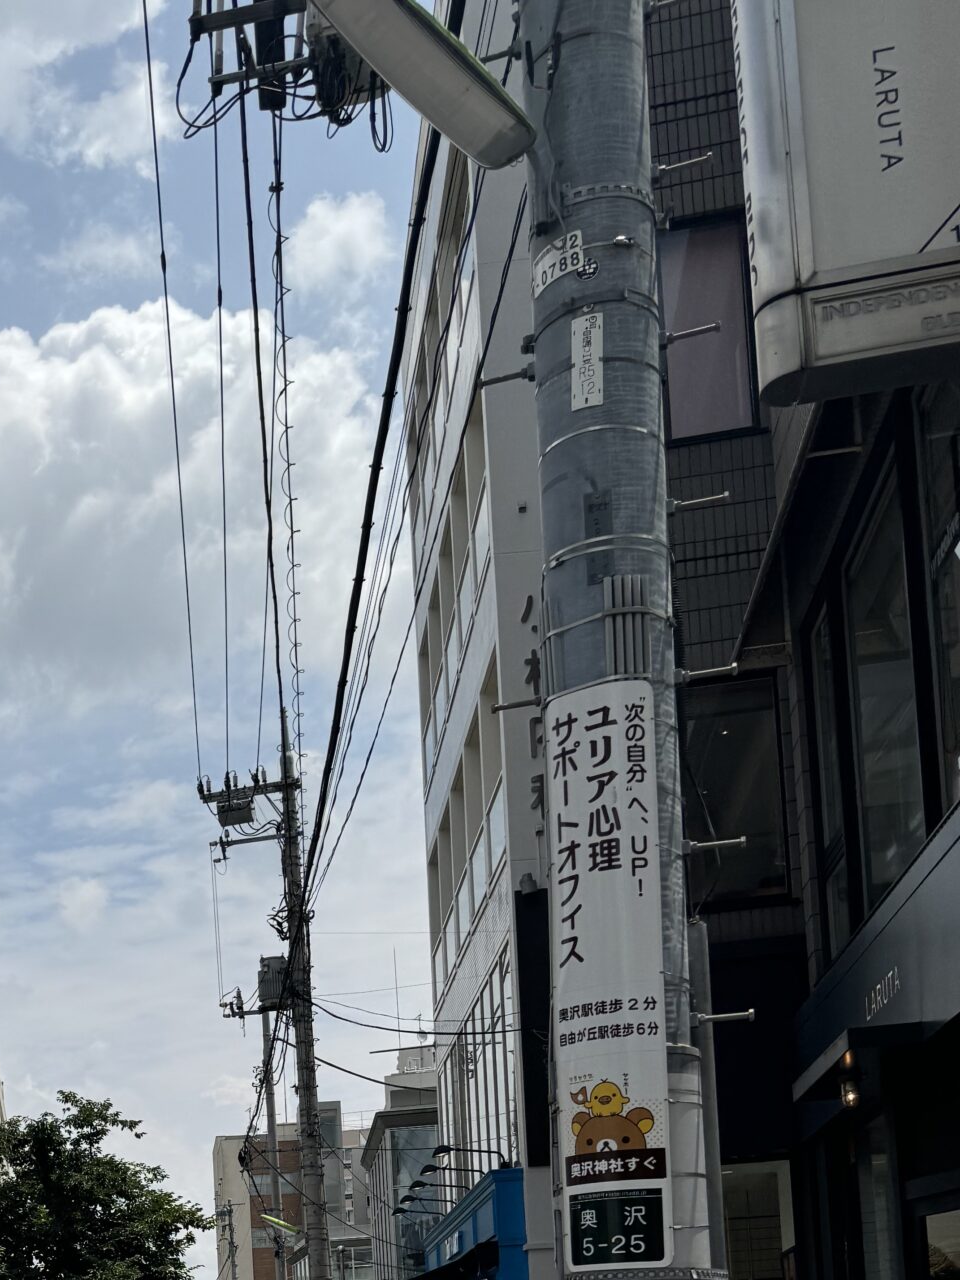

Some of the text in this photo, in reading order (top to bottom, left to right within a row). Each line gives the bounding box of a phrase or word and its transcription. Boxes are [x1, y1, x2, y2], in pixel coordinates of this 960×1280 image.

[872, 47, 904, 171] LARUTA
[584, 705, 622, 872] ユリア心理
[551, 712, 585, 970] サポートオフィス
[865, 966, 901, 1022] LARUTA
[558, 996, 657, 1024] 奥沢駅徒歩2分
[559, 1021, 659, 1047] 自由が丘駅徒歩6分
[570, 1157, 657, 1178] 奥沢神社すぐ
[580, 1206, 647, 1230] 奥沢
[582, 1234, 646, 1257] 5-25
